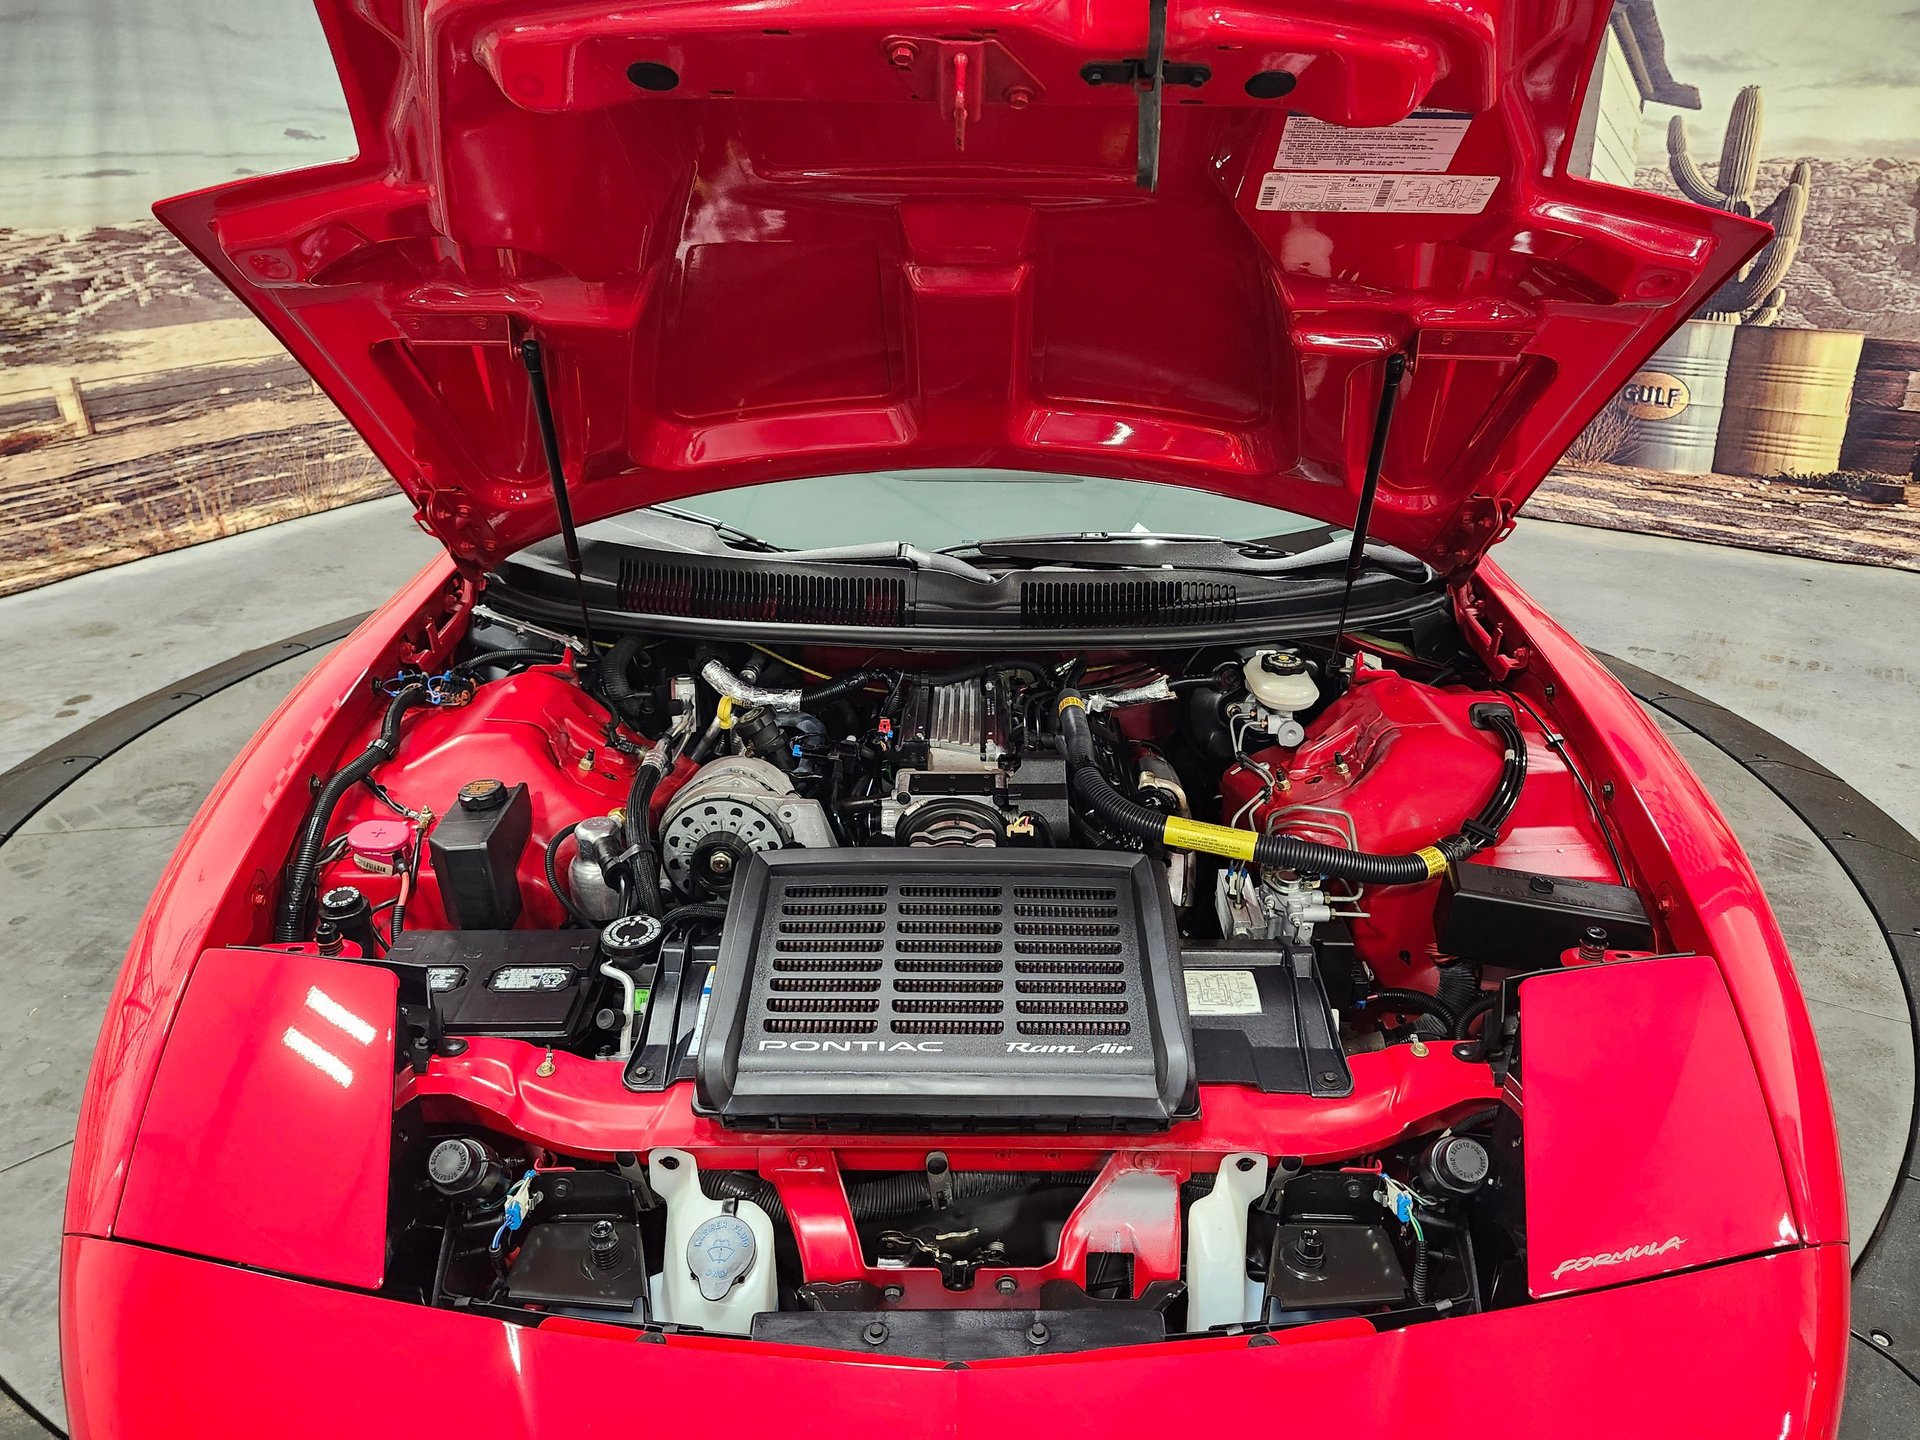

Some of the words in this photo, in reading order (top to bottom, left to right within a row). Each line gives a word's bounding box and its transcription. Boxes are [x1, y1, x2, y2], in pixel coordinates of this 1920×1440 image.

[1623, 384, 1682, 409] GULF
[1425, 853, 1442, 863] FUEL
[758, 1040, 944, 1053] PONTIAC
[1004, 1041, 1085, 1054] Ram
[1086, 1041, 1134, 1055] Air
[693, 1221, 728, 1248] WASHER
[732, 1224, 750, 1248] FLUID
[1549, 1235, 1689, 1281] FORMULA
[704, 1268, 728, 1279] ONLY
